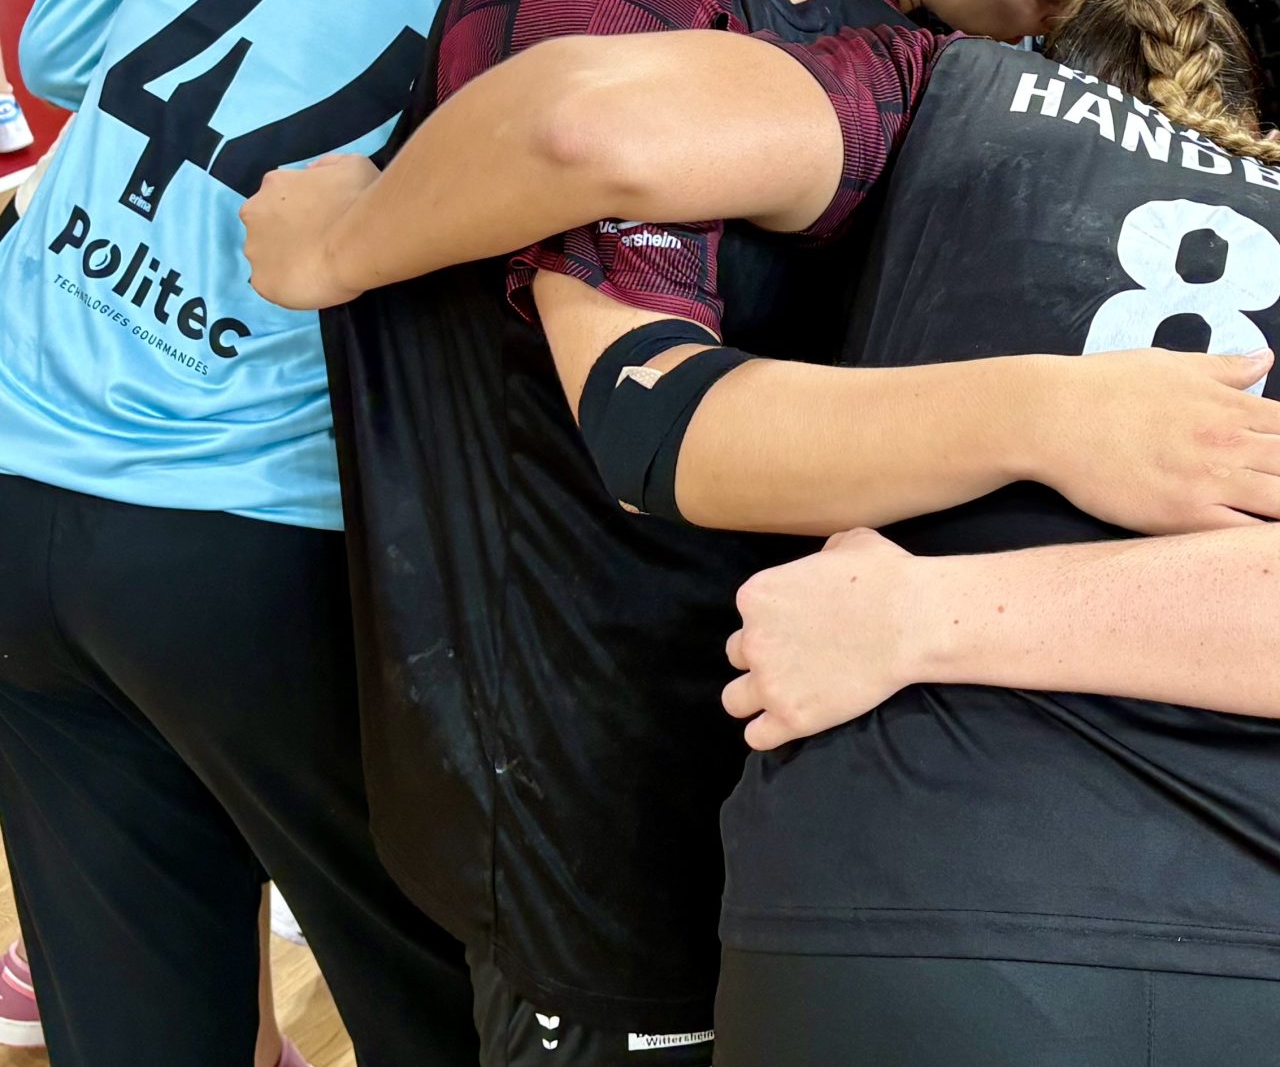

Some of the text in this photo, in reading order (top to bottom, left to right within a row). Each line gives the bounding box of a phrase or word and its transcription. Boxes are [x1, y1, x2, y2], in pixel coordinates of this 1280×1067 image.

[128, 192, 152, 213] erima
[48, 204, 252, 359] Politec
[53, 273, 209, 376] TECHNOLOGIES GOURMANDES
